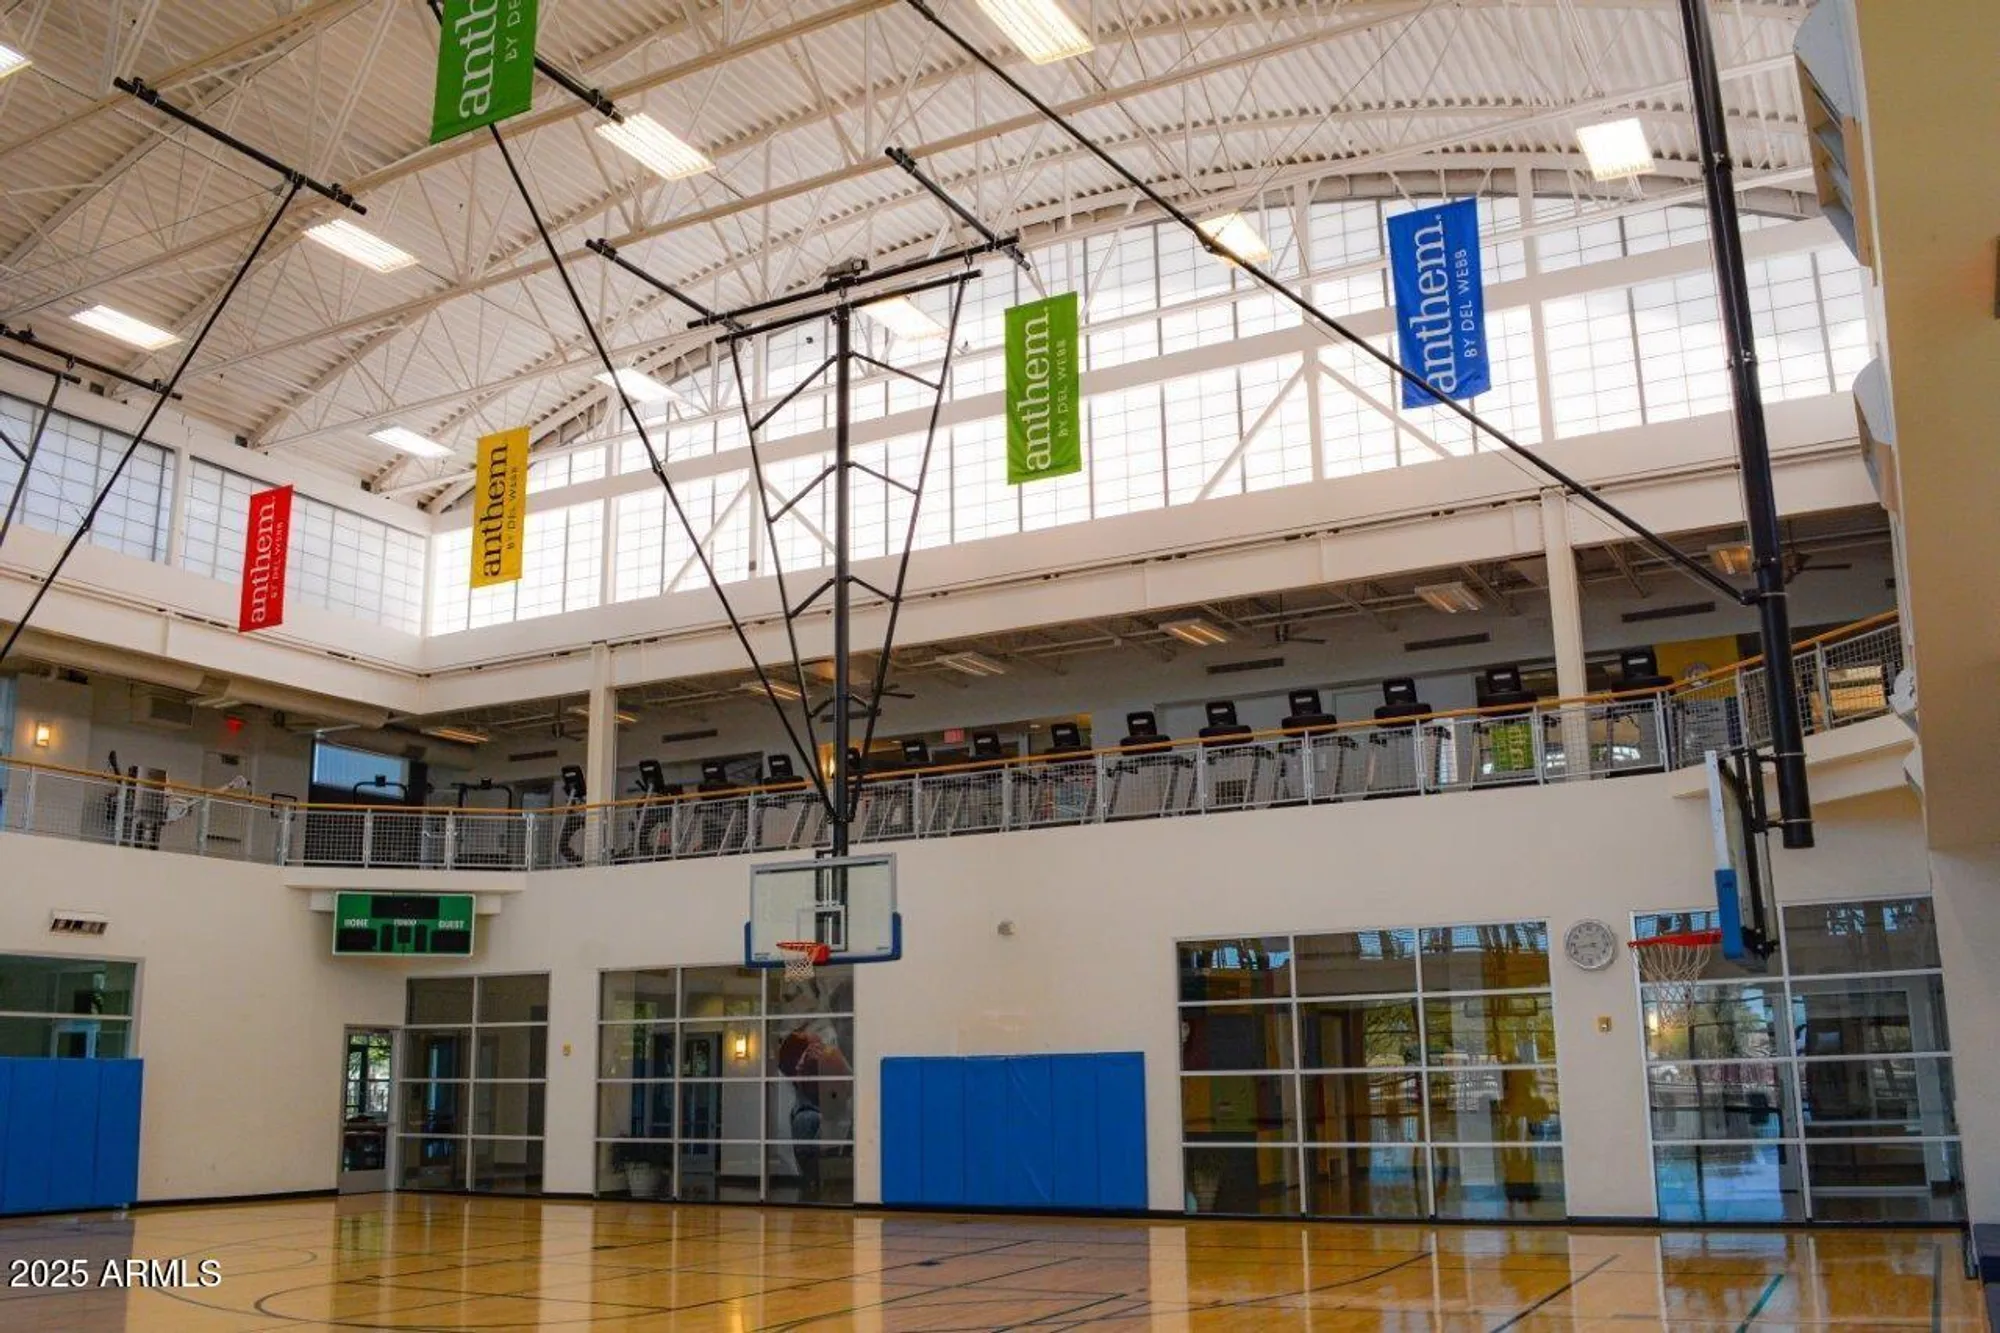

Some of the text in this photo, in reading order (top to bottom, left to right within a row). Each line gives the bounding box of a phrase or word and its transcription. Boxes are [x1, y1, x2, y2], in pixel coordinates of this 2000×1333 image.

[504, 36, 518, 62] BY
[1454, 248, 1478, 358] BY DEL WEBB
[1057, 385, 1069, 414] DEL
[1057, 419, 1069, 438] BY
